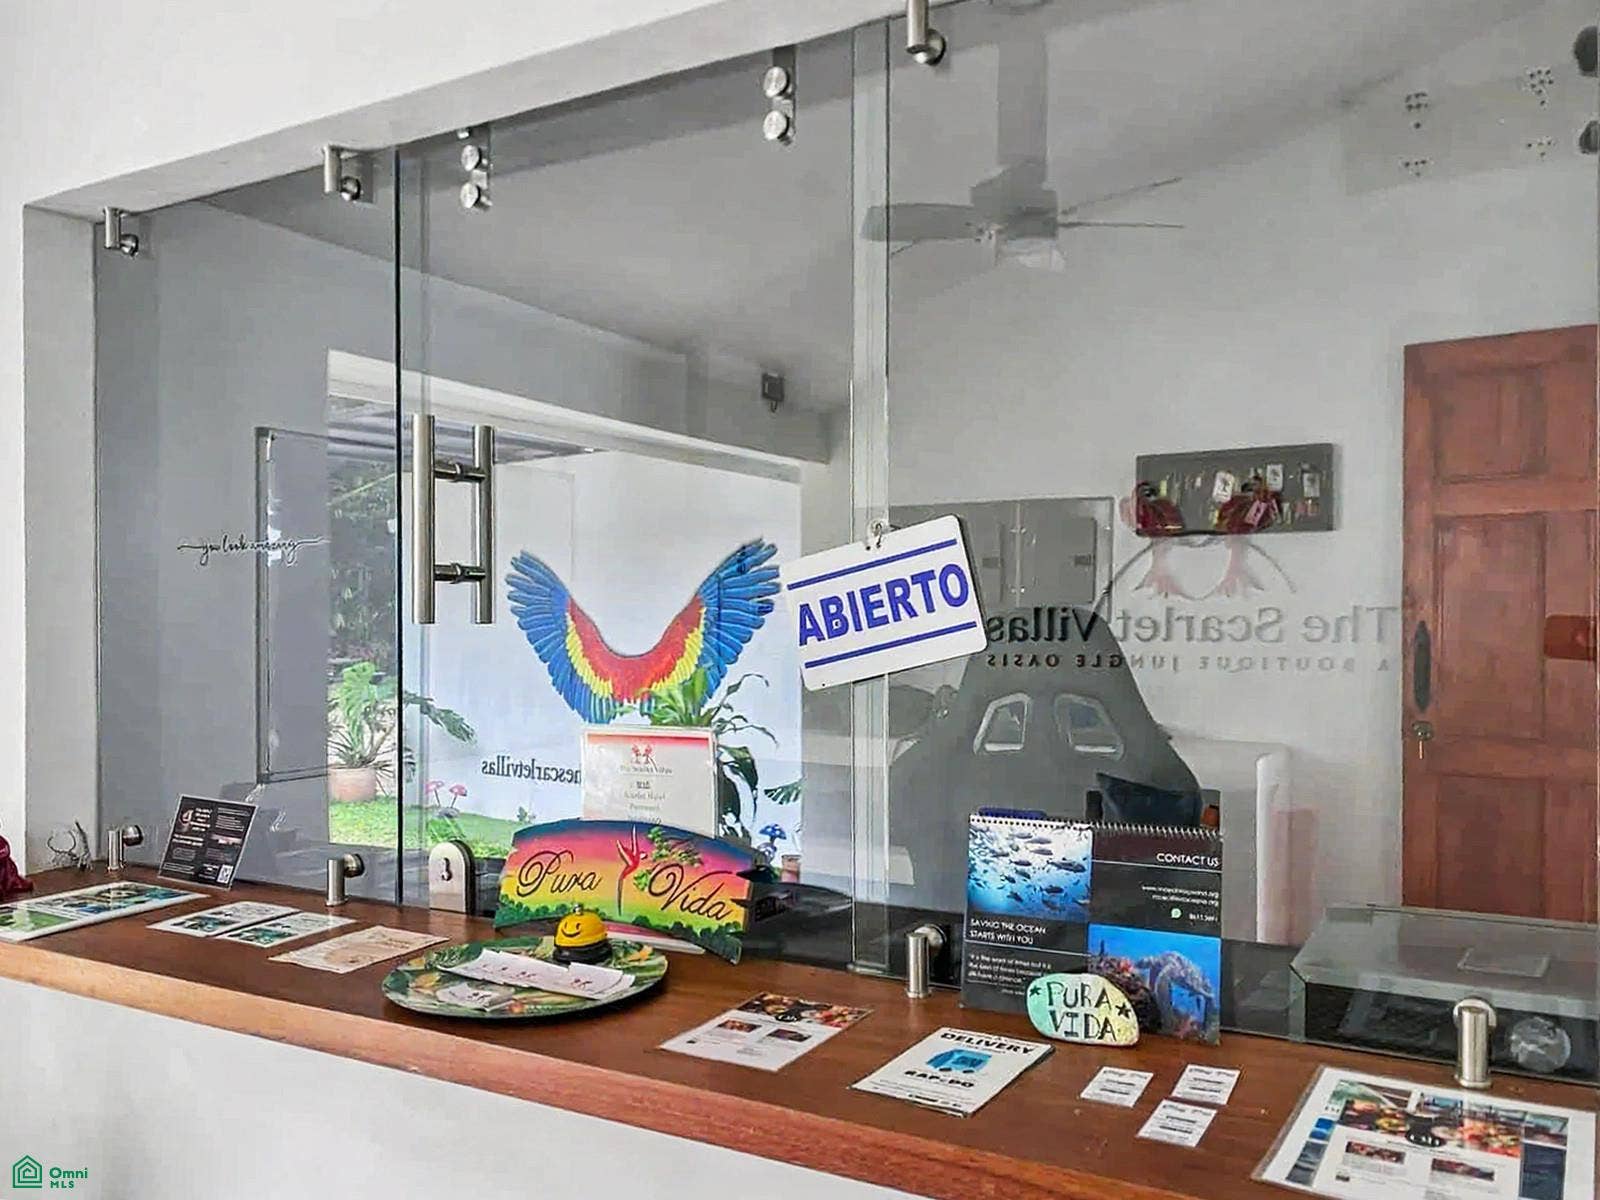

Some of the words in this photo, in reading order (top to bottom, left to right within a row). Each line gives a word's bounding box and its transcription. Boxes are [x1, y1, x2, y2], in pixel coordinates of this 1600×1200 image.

[222, 534, 248, 553] look
[799, 563, 969, 646] ABIERTO
[1156, 853, 1206, 865] CONTACT
[1207, 857, 1219, 867] US
[516, 850, 602, 898] Pura
[648, 863, 732, 920] Vida
[1016, 924, 1046, 934] OCEAN
[1016, 935, 1034, 945] YOU
[1046, 981, 1113, 1011] PURA
[1050, 1010, 1119, 1042] VIDA
[940, 1032, 1035, 1055] DELIVERY
